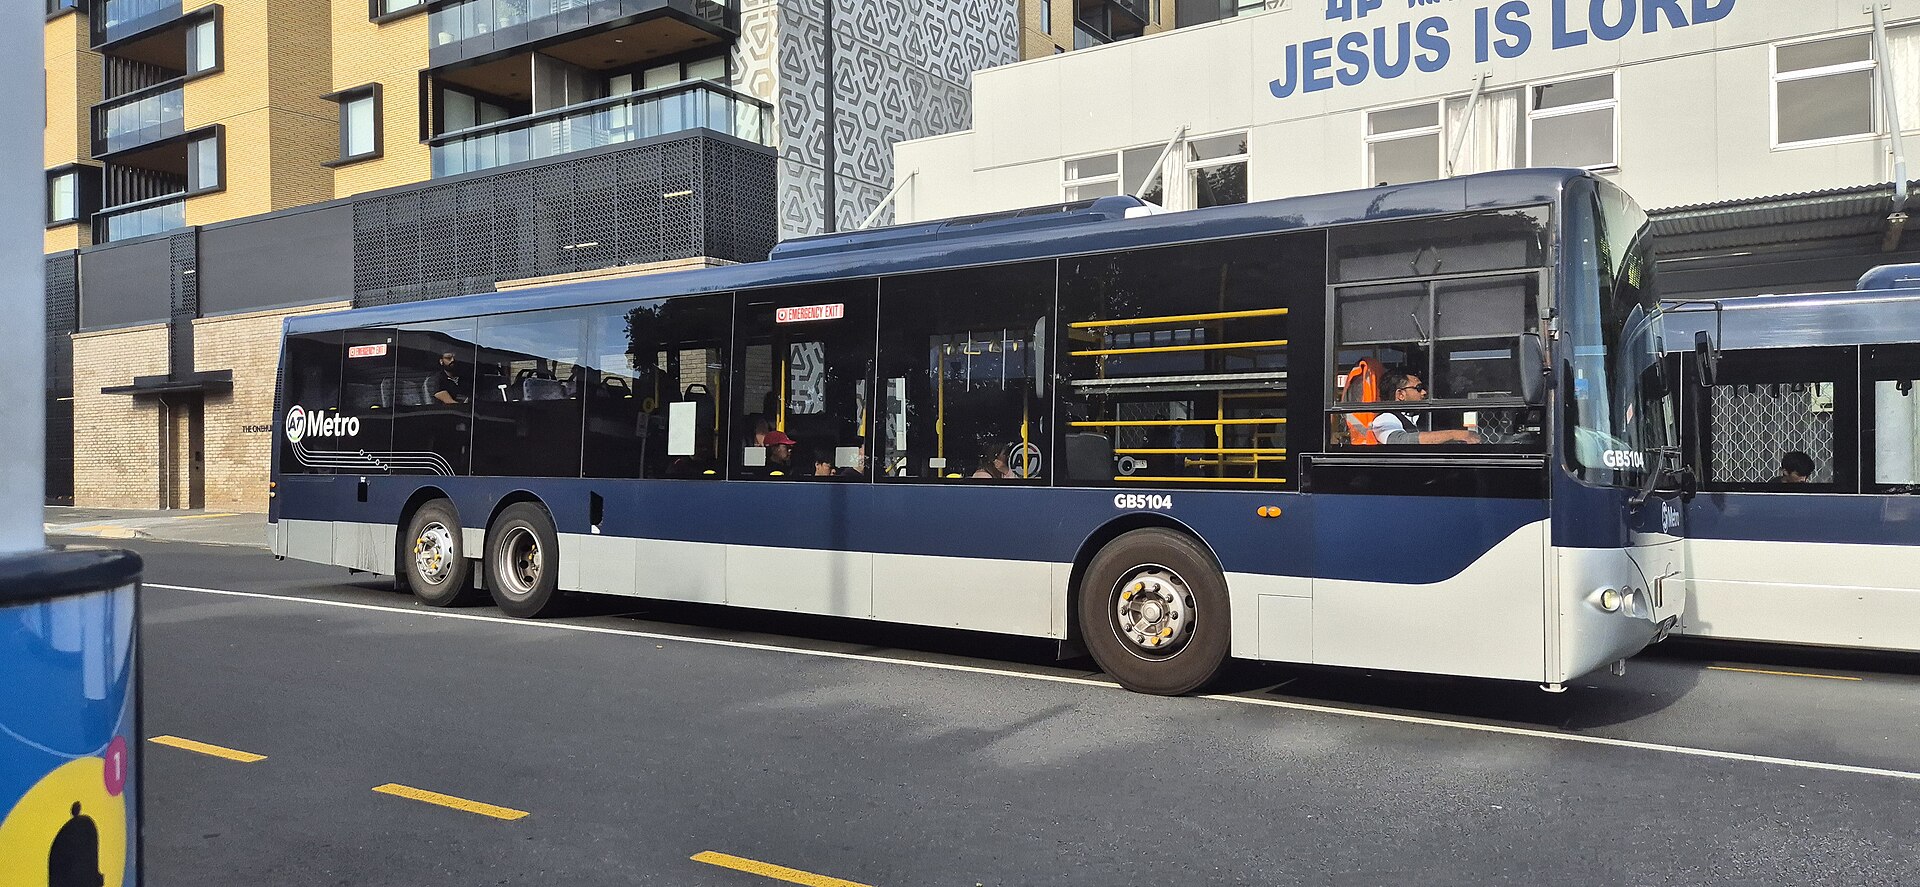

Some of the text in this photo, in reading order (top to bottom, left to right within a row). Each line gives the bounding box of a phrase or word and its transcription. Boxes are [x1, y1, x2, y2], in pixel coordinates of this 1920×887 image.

[1268, 16, 1451, 99] JESUS
[1474, 0, 1533, 64] IS
[788, 305, 838, 320] EMERGENCY EXIT
[242, 425, 252, 433] THE
[307, 410, 360, 437] Metro
[1603, 449, 1644, 468] GB5104
[1114, 493, 1173, 509] GB5104
[113, 752, 121, 781] 1
